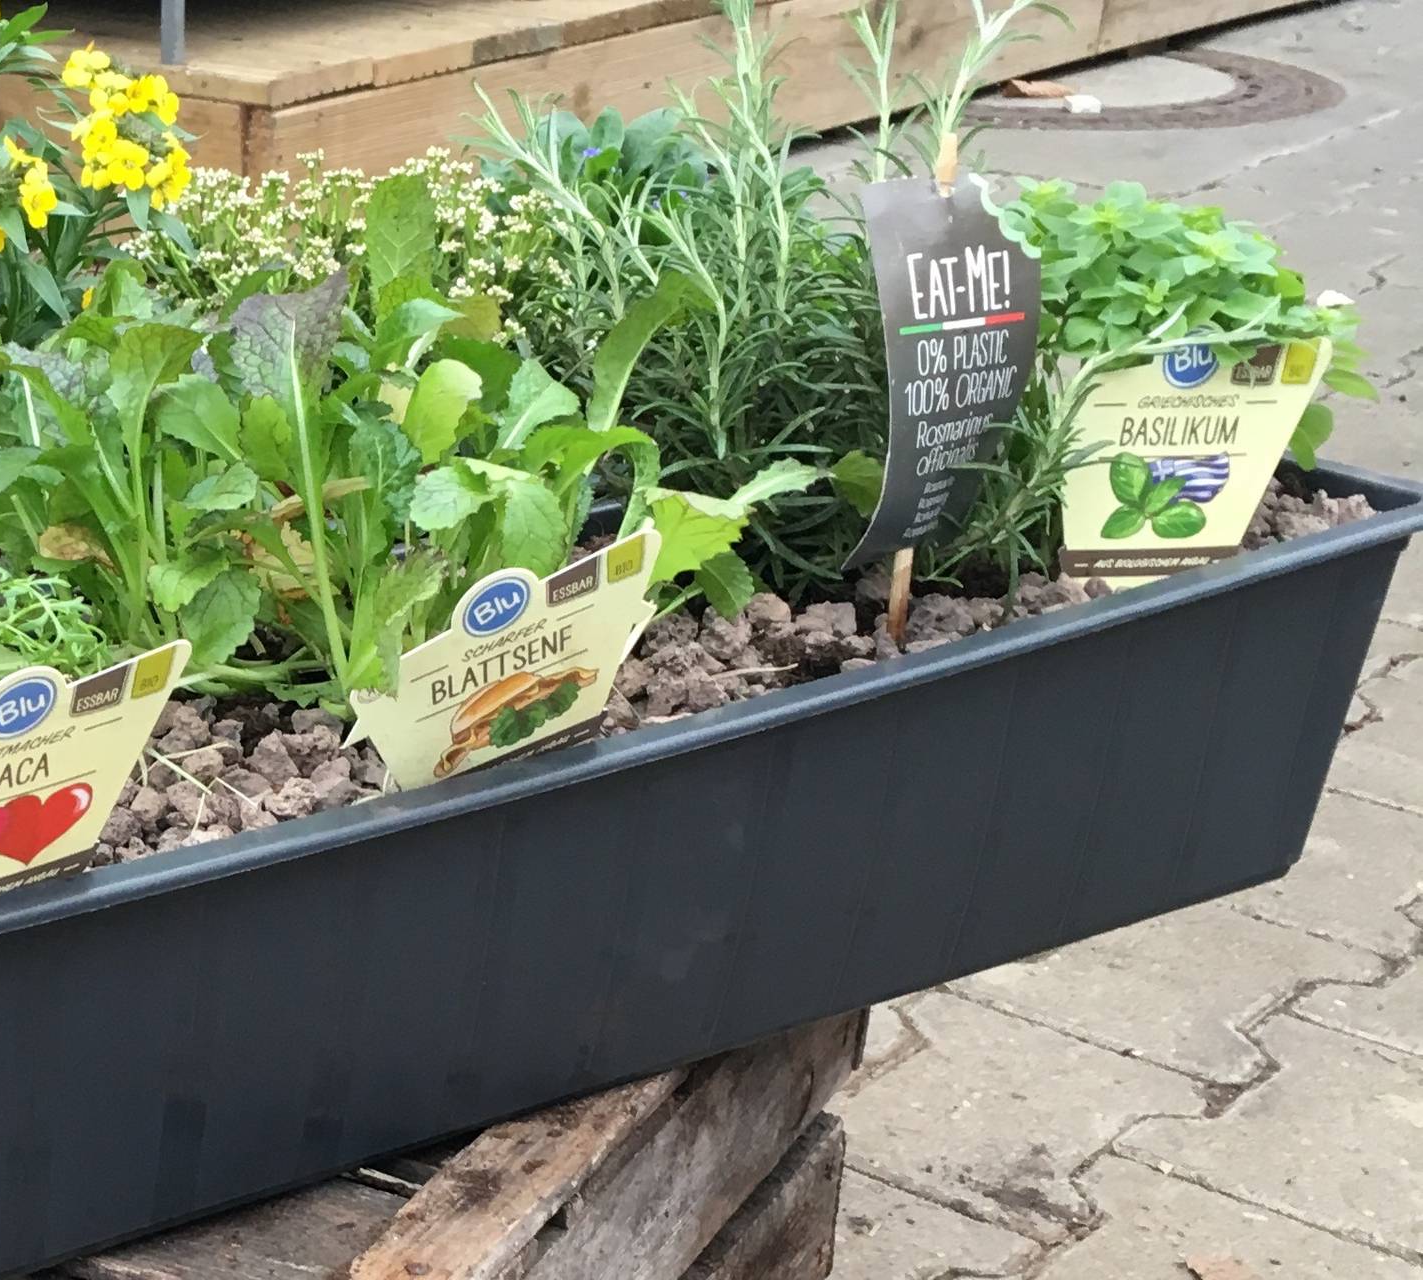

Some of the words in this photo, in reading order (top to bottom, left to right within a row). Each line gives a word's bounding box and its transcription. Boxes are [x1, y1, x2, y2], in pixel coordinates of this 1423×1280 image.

[918, 338, 947, 376] 0%
[954, 329, 1009, 370] PLASTIC
[904, 377, 950, 416] 100%
[955, 365, 1017, 409] ORGANIC
[1137, 394, 1240, 409] GRIECHISCHES
[916, 410, 993, 449] Rosmarinus
[1119, 415, 1240, 446] BASILIKUM
[614, 560, 633, 577] BIO
[552, 575, 594, 602] ESSBAR
[473, 590, 521, 625] Blu
[462, 618, 547, 663] SCHARFER
[432, 624, 573, 706] BLATTSENF
[76, 686, 119, 712] ESSBAR
